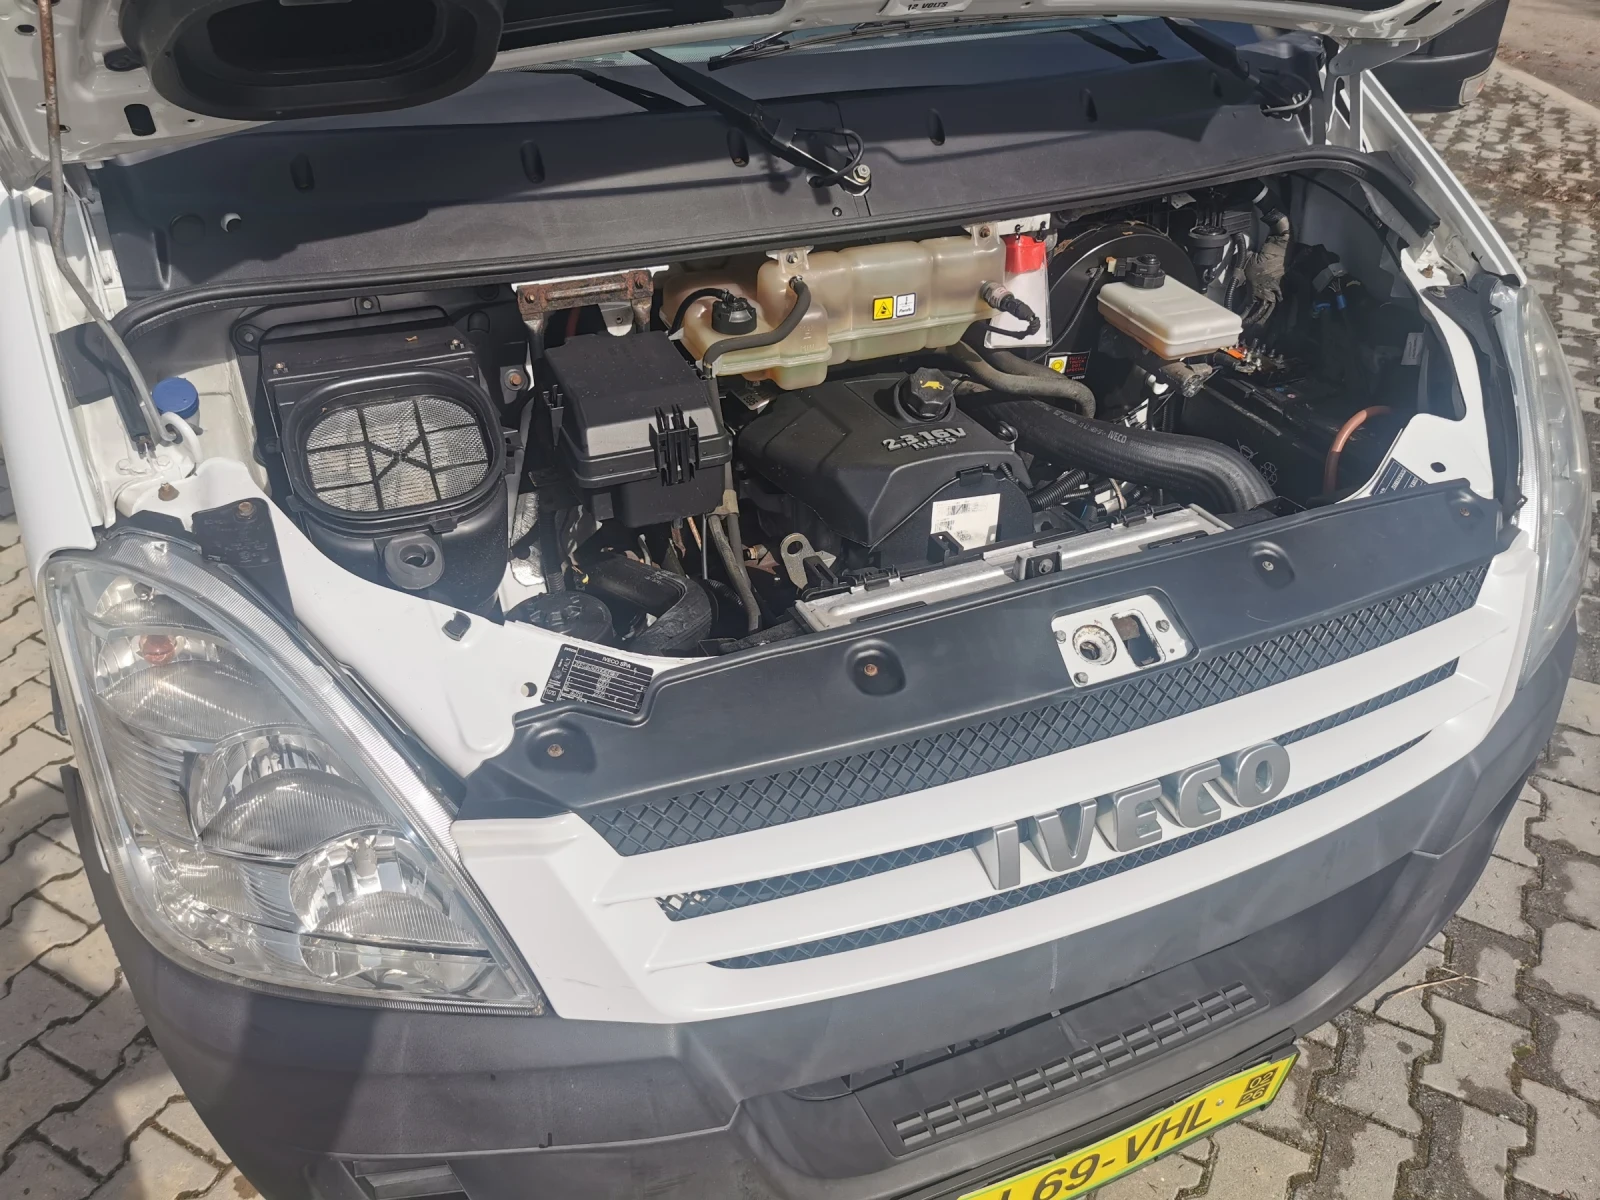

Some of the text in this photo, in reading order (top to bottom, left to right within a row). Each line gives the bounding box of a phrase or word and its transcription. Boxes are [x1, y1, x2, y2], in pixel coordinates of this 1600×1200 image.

[907, 1, 948, 11] 12 VOLTS
[912, 437, 957, 450] IVECO
[1107, 430, 1128, 444] IVECO
[602, 656, 620, 666] IVECO
[988, 740, 1291, 891] IVECO
[1249, 1071, 1274, 1089] 02
[1239, 1087, 1265, 1105] 26
